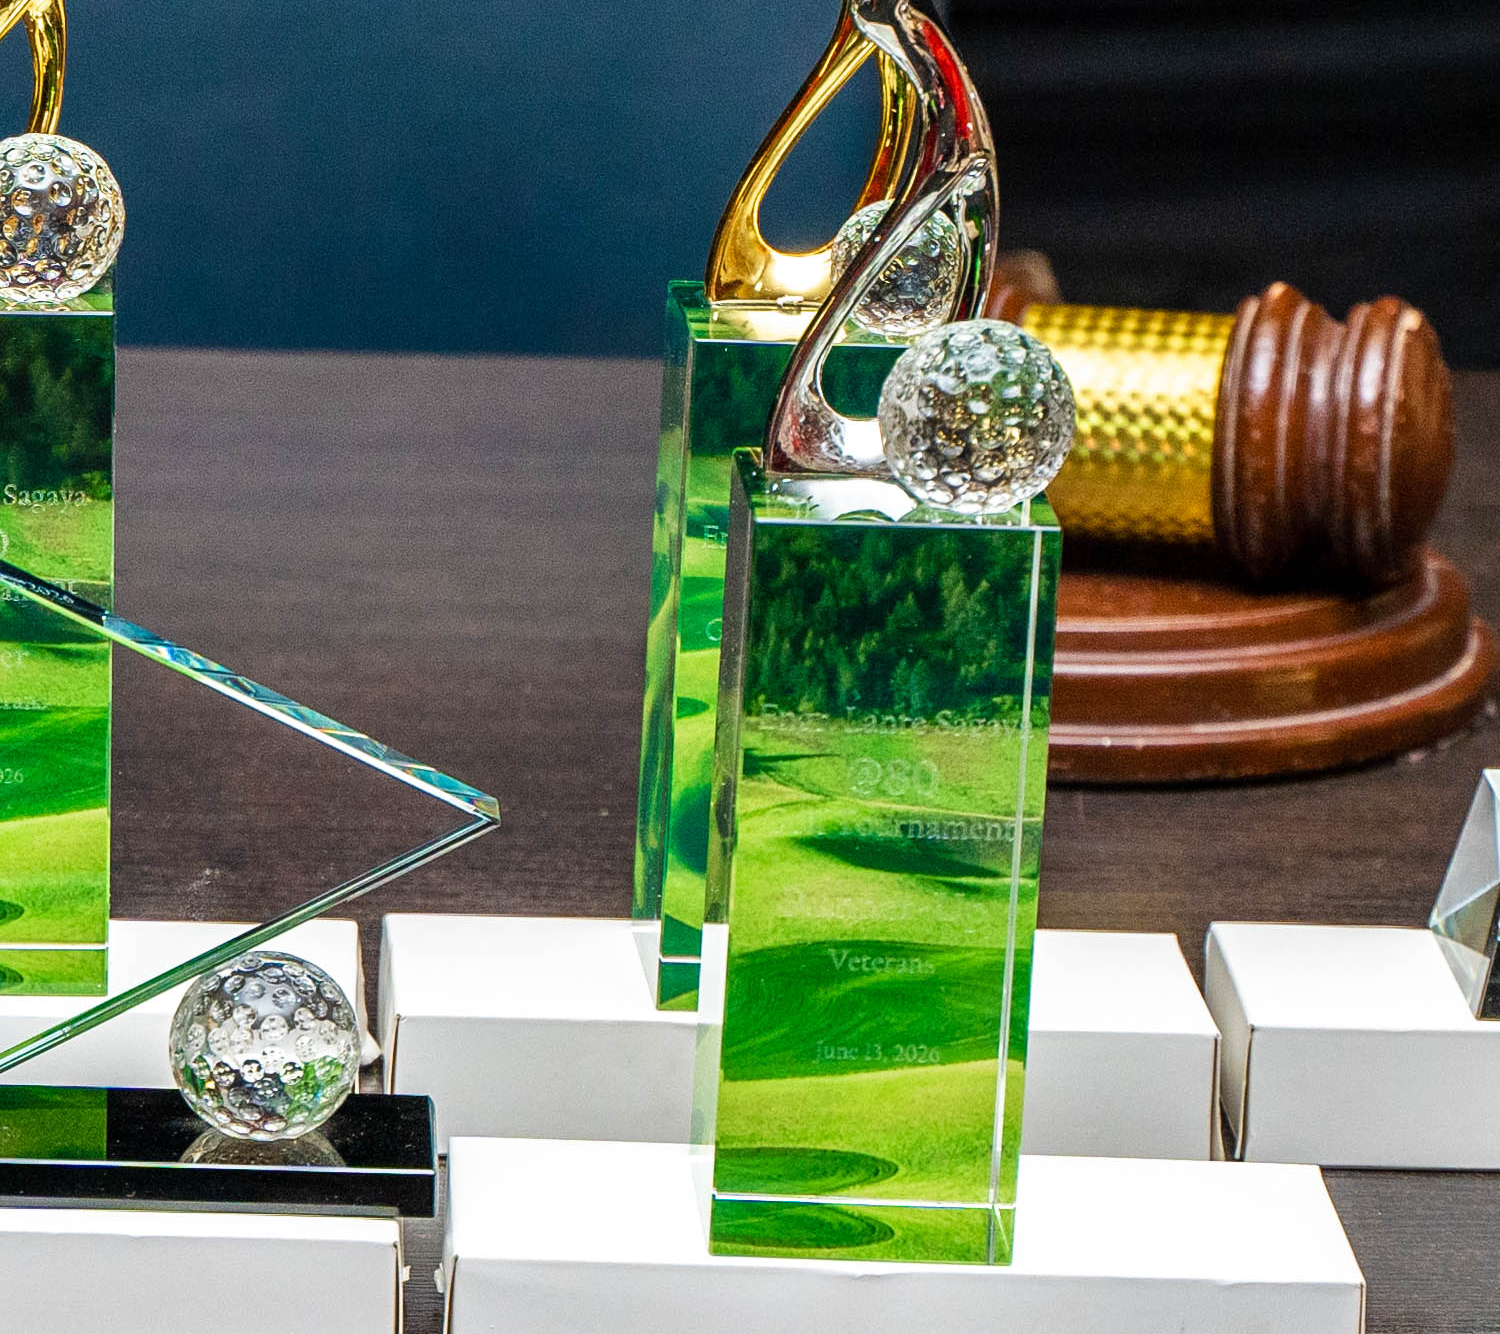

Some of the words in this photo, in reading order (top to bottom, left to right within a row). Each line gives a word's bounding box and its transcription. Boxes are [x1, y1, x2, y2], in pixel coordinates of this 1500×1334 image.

[3, 484, 89, 514] Sagaya
[827, 948, 936, 974] Veterans
[893, 1044, 941, 1064] 2026
